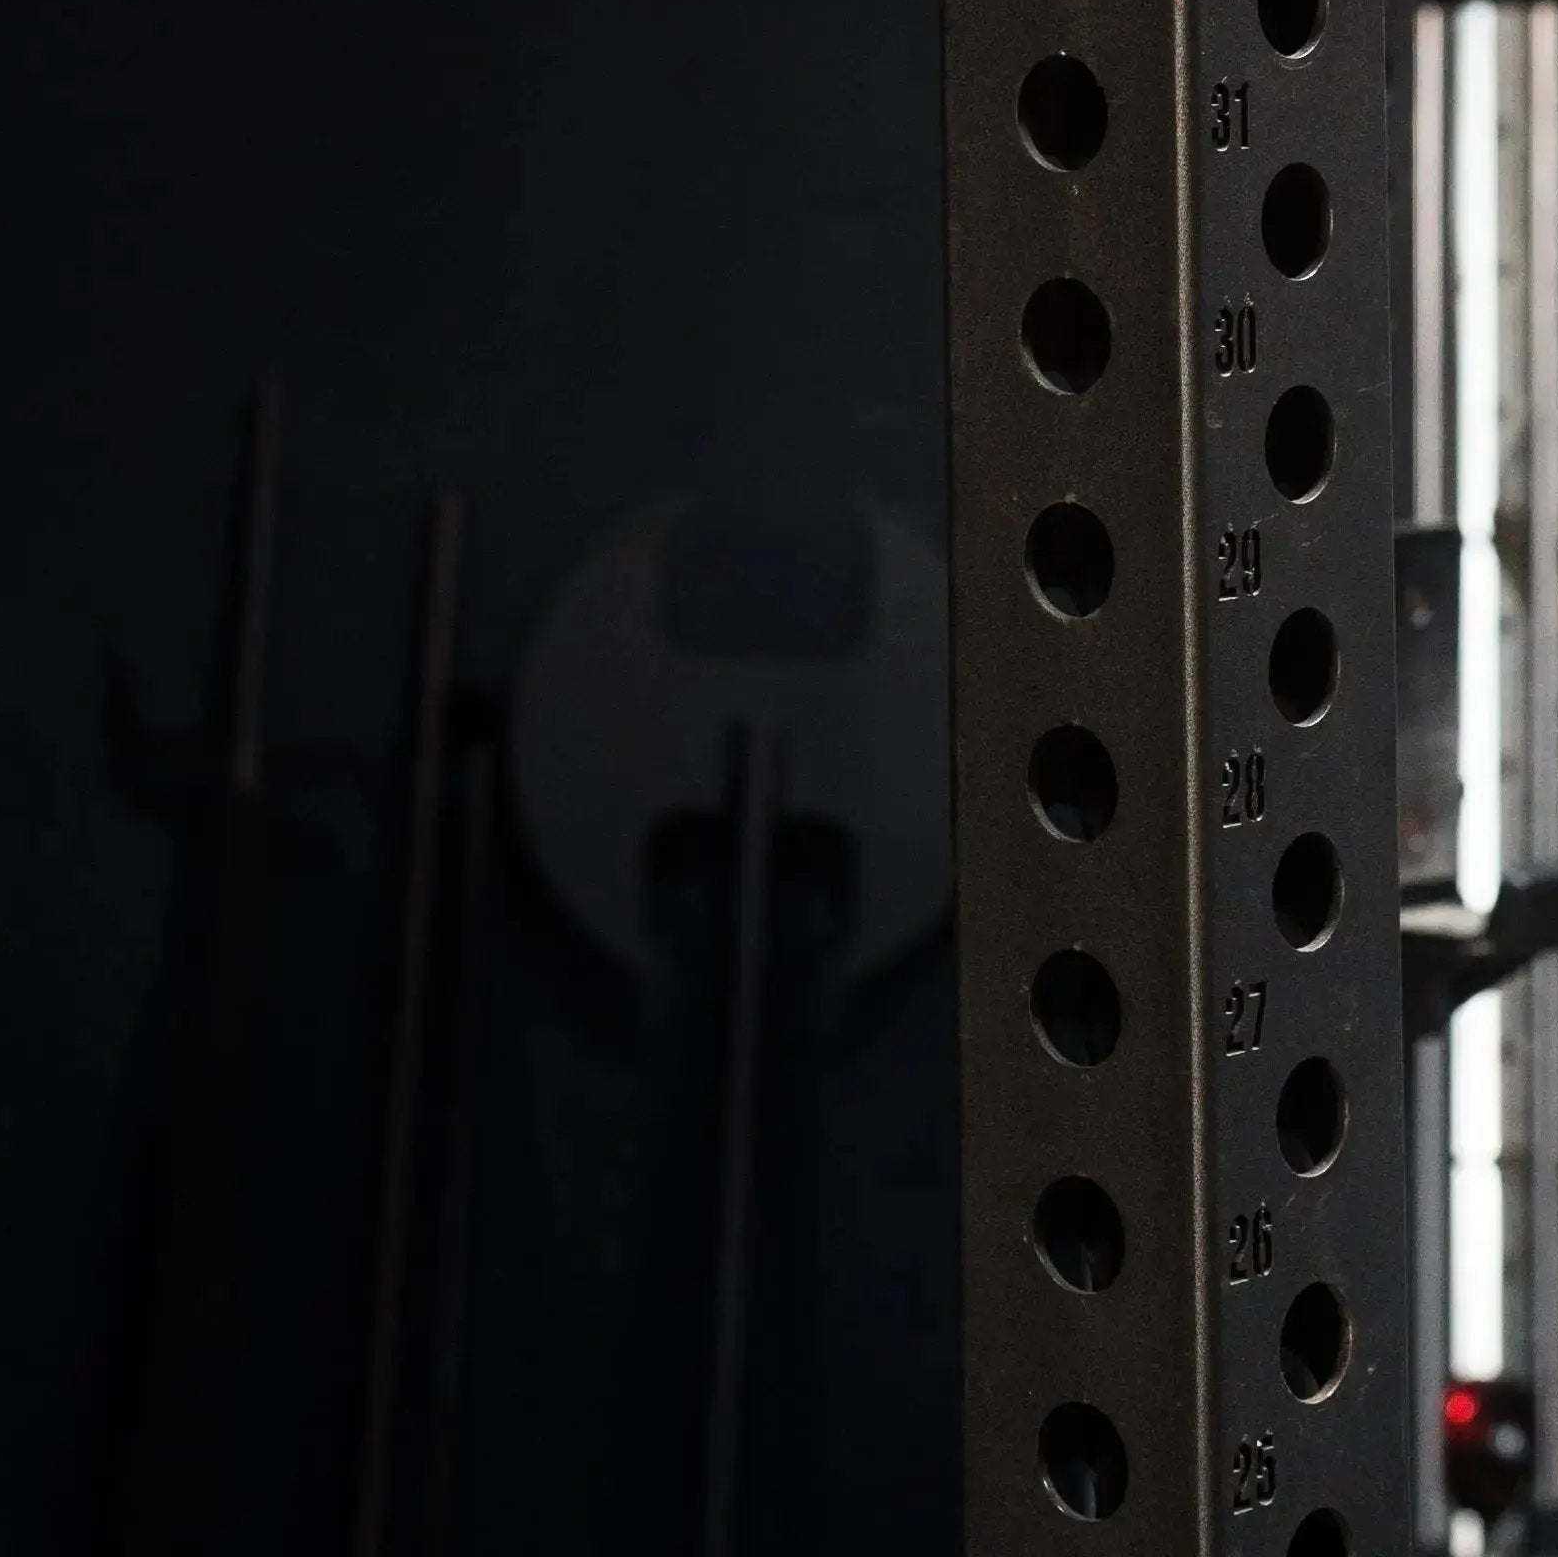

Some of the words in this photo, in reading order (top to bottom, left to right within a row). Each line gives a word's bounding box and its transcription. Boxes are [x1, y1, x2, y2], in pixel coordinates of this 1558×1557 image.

[1210, 82, 1250, 152] 31
[1213, 305, 1257, 377] 30
[1217, 527, 1262, 602] 29
[1221, 751, 1266, 829] 28
[1225, 981, 1267, 1057] 27
[1229, 1207, 1274, 1285] 26
[1233, 1435, 1277, 1516] 25
